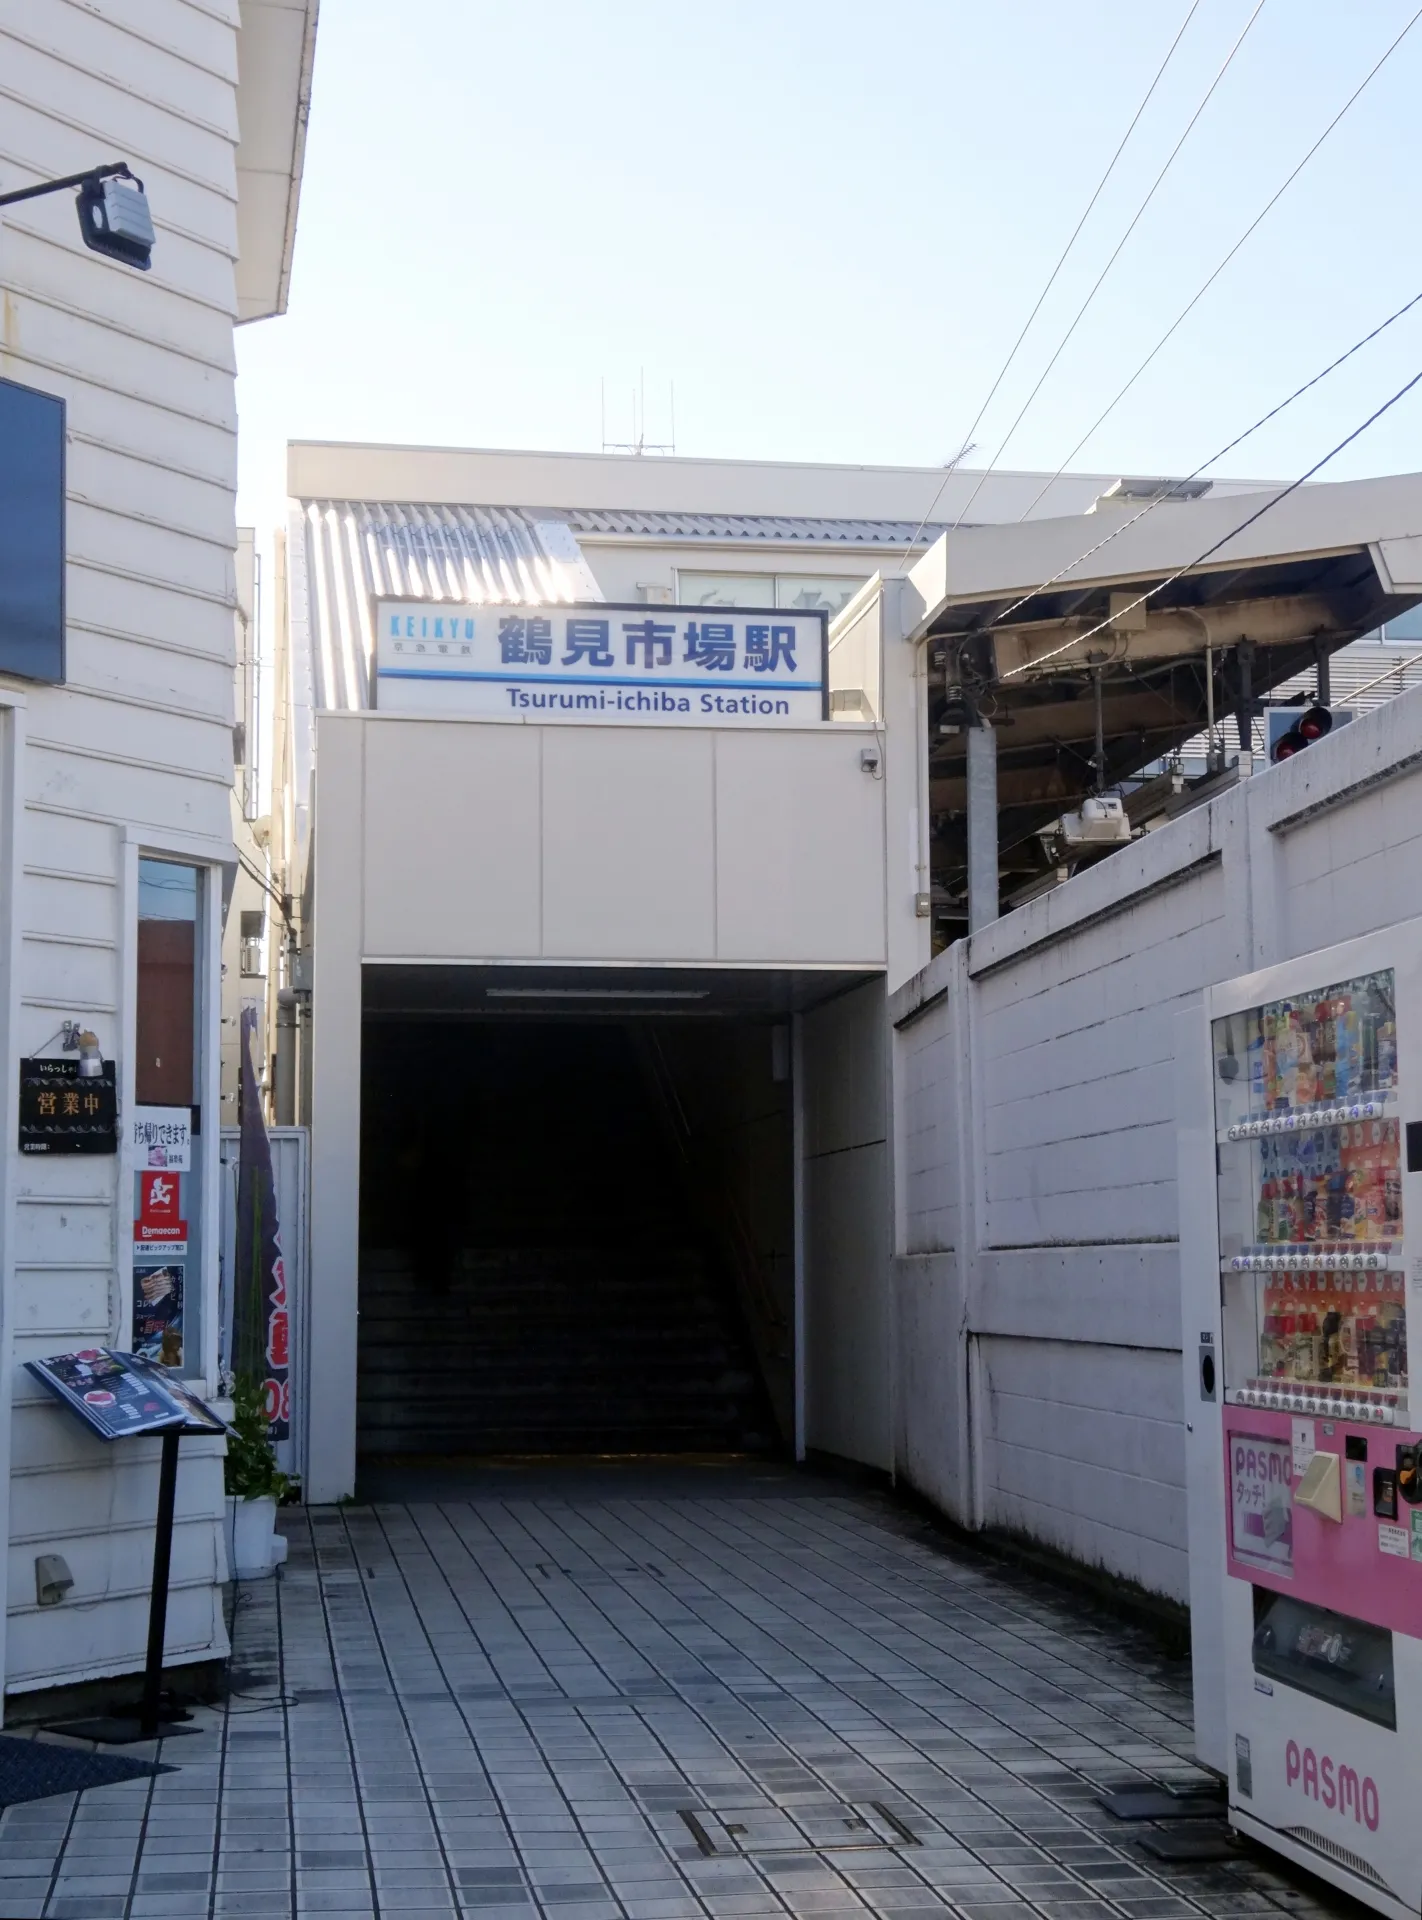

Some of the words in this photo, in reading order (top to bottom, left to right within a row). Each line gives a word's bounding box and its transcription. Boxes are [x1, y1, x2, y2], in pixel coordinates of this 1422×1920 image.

[390, 615, 474, 640] KEIKYU
[498, 614, 798, 673] 鶴見市場駅
[506, 688, 690, 713] Tsurumi-ichiba
[700, 694, 789, 715] Station
[38, 1092, 99, 1115] 営業中
[142, 1226, 180, 1237] Demaecan
[1236, 1447, 1292, 1487] PASMO
[1236, 1480, 1266, 1508] タッチ!
[1286, 1739, 1379, 1832] PASMO
